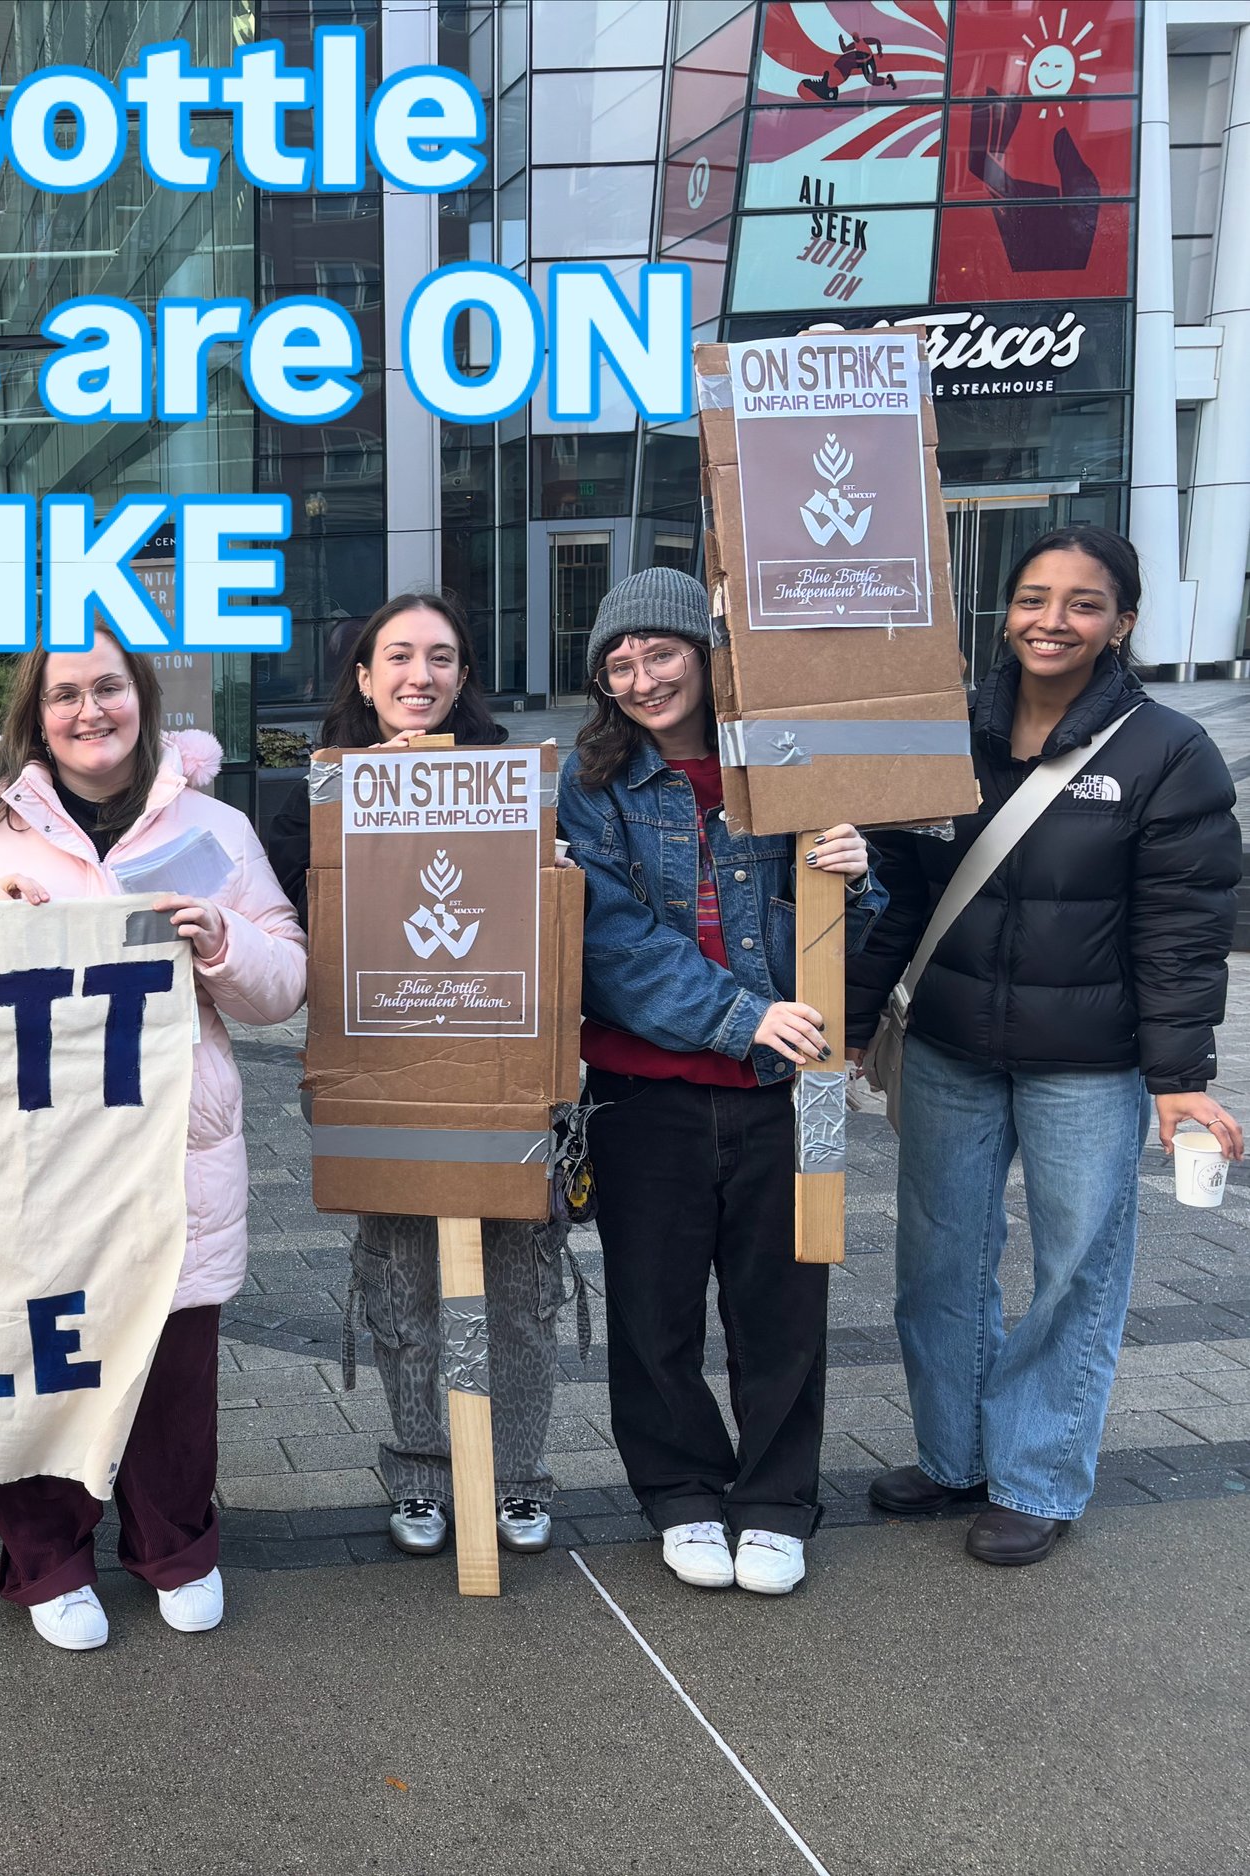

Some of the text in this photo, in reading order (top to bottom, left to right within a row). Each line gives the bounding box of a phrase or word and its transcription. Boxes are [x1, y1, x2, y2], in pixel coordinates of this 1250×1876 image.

[811, 212, 868, 250] SEEK
[741, 345, 907, 393] ON STRIKE
[952, 380, 1054, 396] STEAKHOUSE
[744, 392, 908, 412] UNFAIR EMPLOYER
[795, 566, 881, 584] Blue Bottle
[773, 583, 905, 605] Independent Union
[353, 760, 527, 808] ON STRIKE
[1065, 782, 1102, 792] NORTH
[1081, 774, 1103, 783] THE
[1074, 791, 1102, 800] FACE
[354, 808, 528, 827] UNFAIR EMPLOYER
[453, 907, 486, 915] MMXXIV
[395, 978, 487, 995] Blue Bottle
[371, 993, 511, 1014] Independent Union
